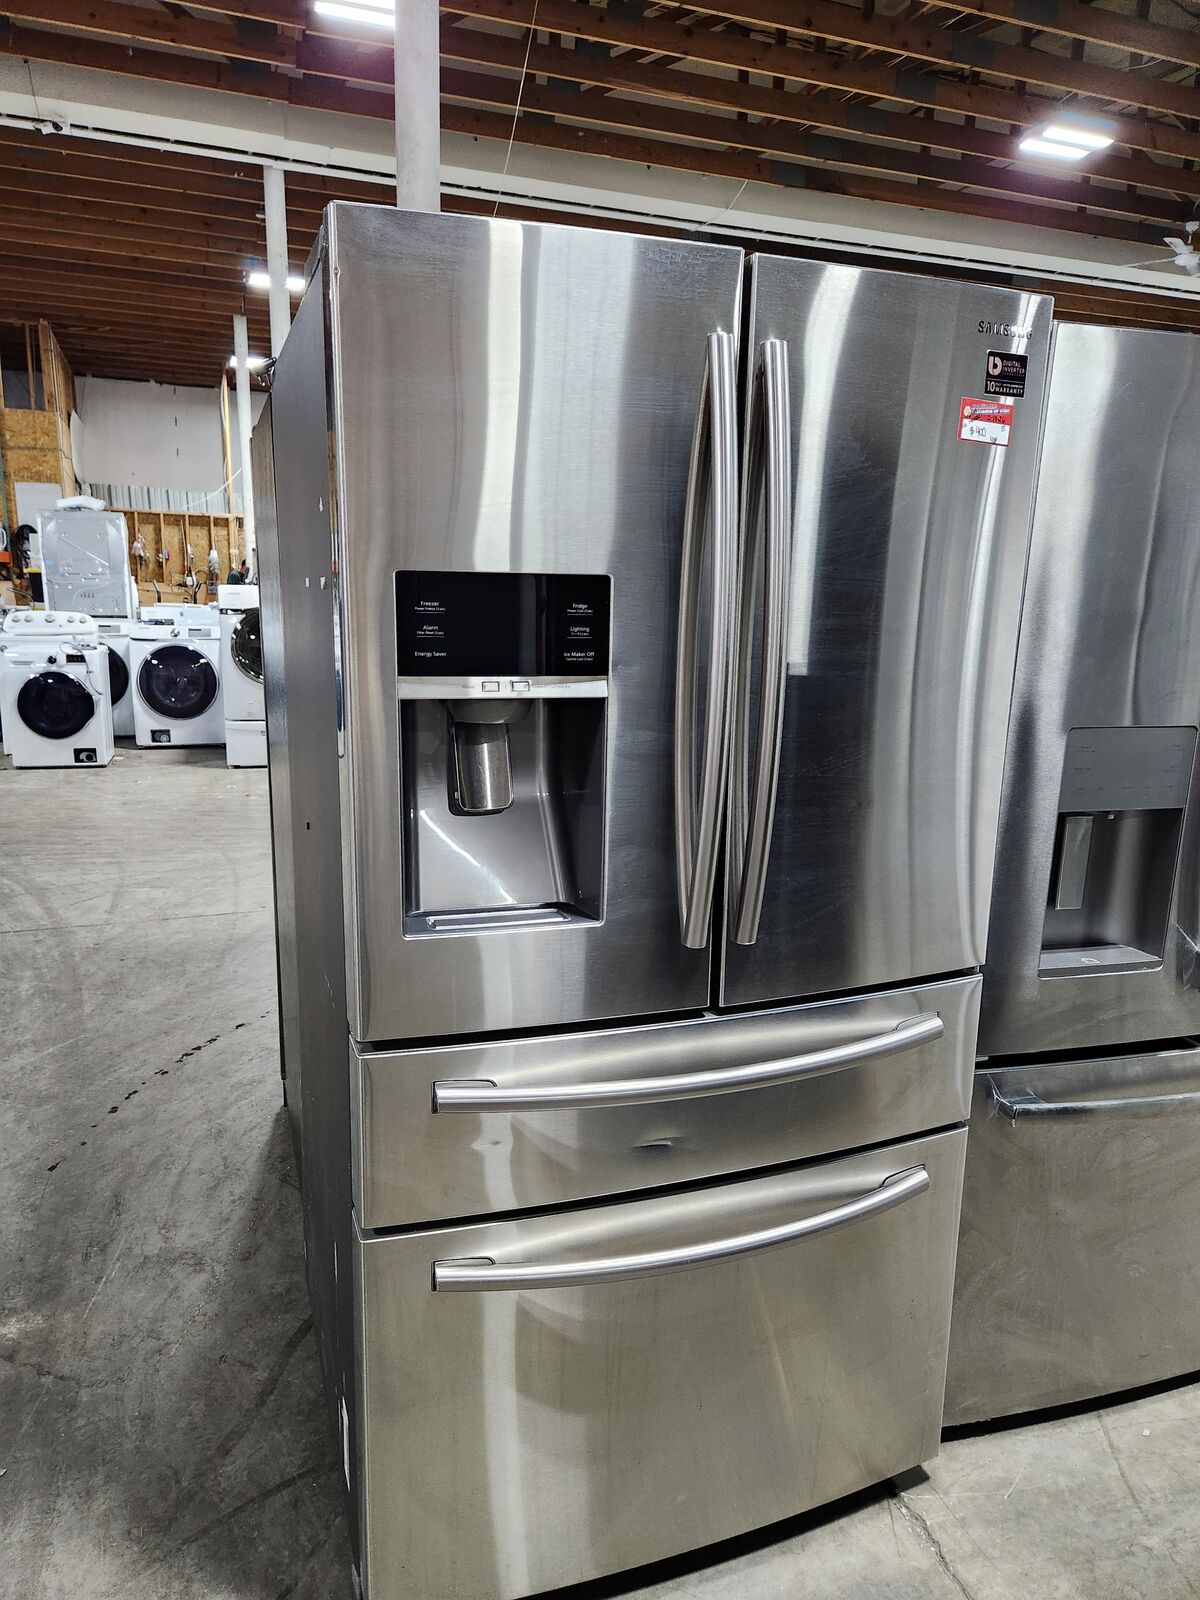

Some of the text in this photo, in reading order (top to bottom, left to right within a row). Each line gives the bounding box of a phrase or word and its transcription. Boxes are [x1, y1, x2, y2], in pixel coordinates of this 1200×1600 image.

[1003, 360, 1021, 368] DIGITAL
[1003, 366, 1025, 375] INVERTER
[987, 381, 996, 392] 10
[995, 387, 1024, 395] WARRANTY
